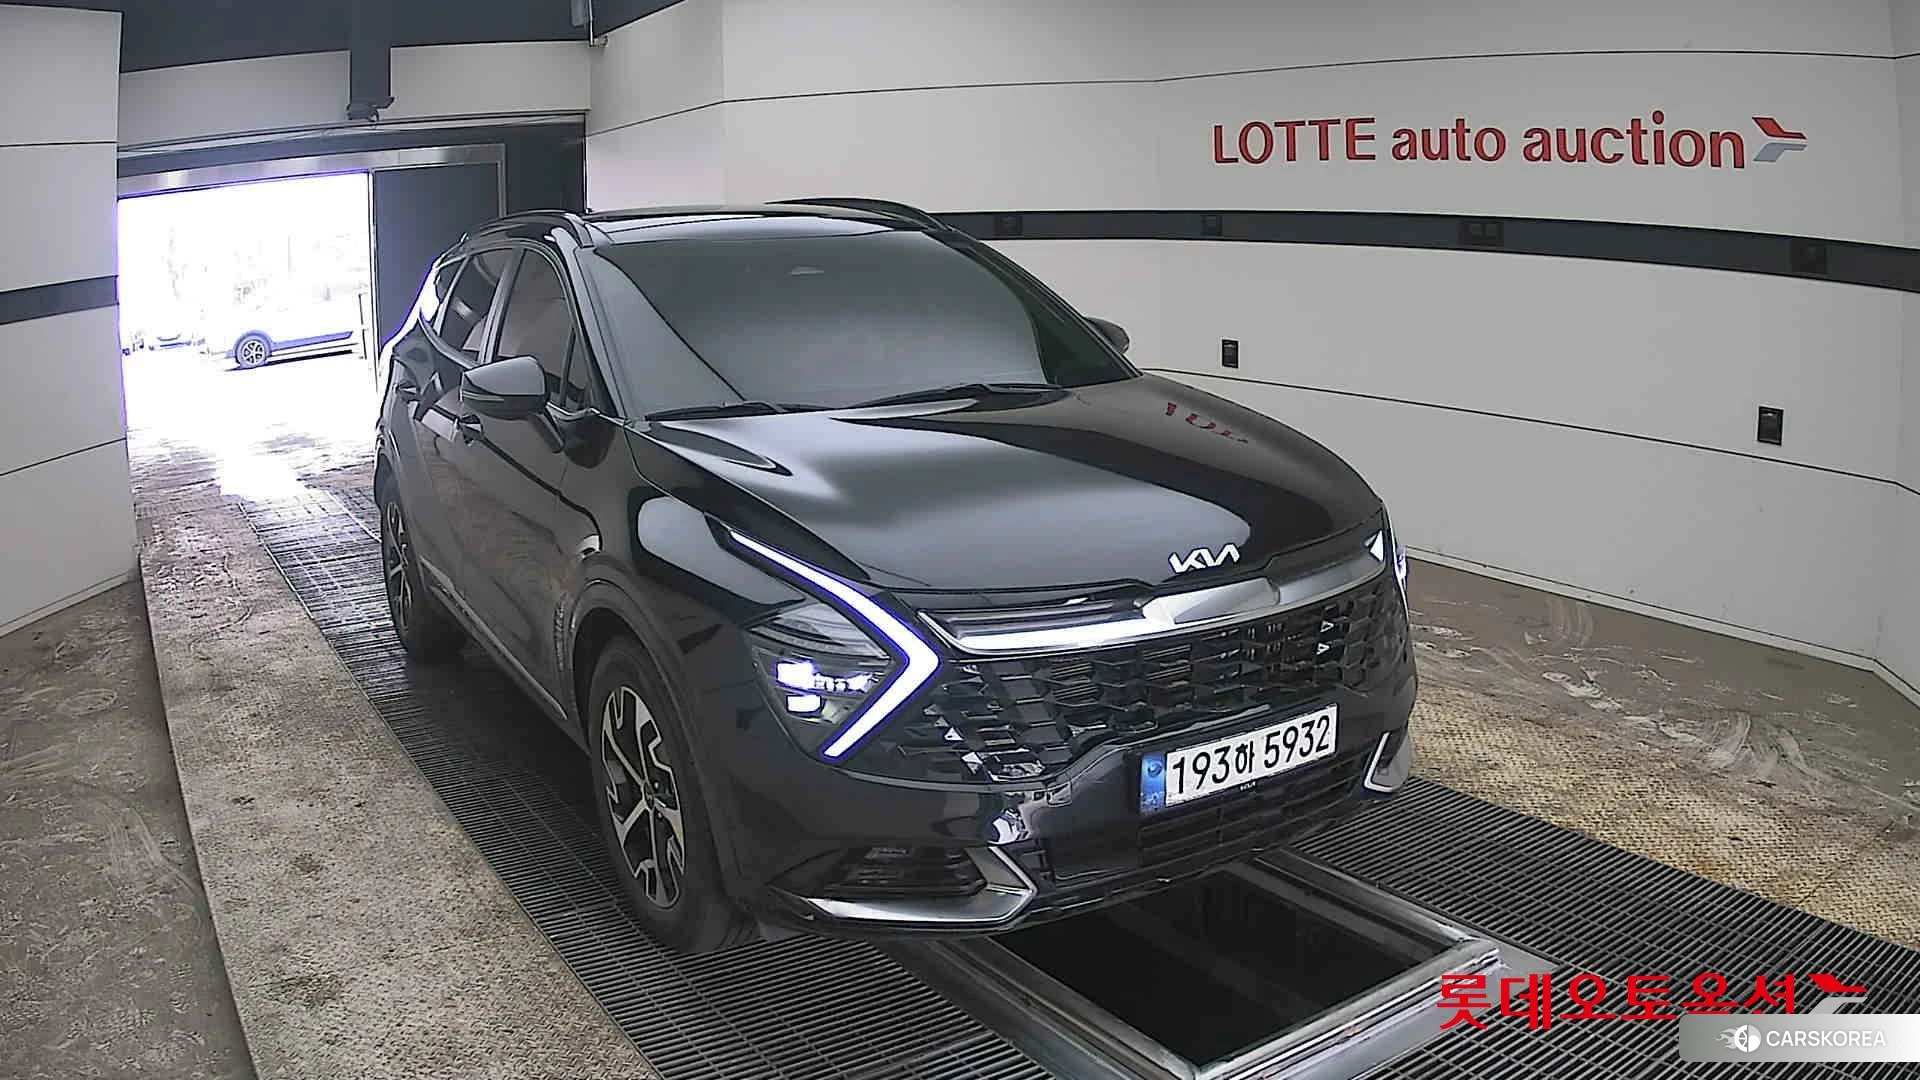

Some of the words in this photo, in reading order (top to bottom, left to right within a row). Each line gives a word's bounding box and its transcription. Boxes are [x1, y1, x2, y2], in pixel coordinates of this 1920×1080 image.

[1213, 117, 1376, 163] LOTTE
[1391, 118, 1507, 162] auto
[1523, 111, 1746, 168] auction
[1168, 543, 1240, 573] KIA
[1172, 740, 1255, 795] 193하
[1263, 715, 1330, 769] 5932
